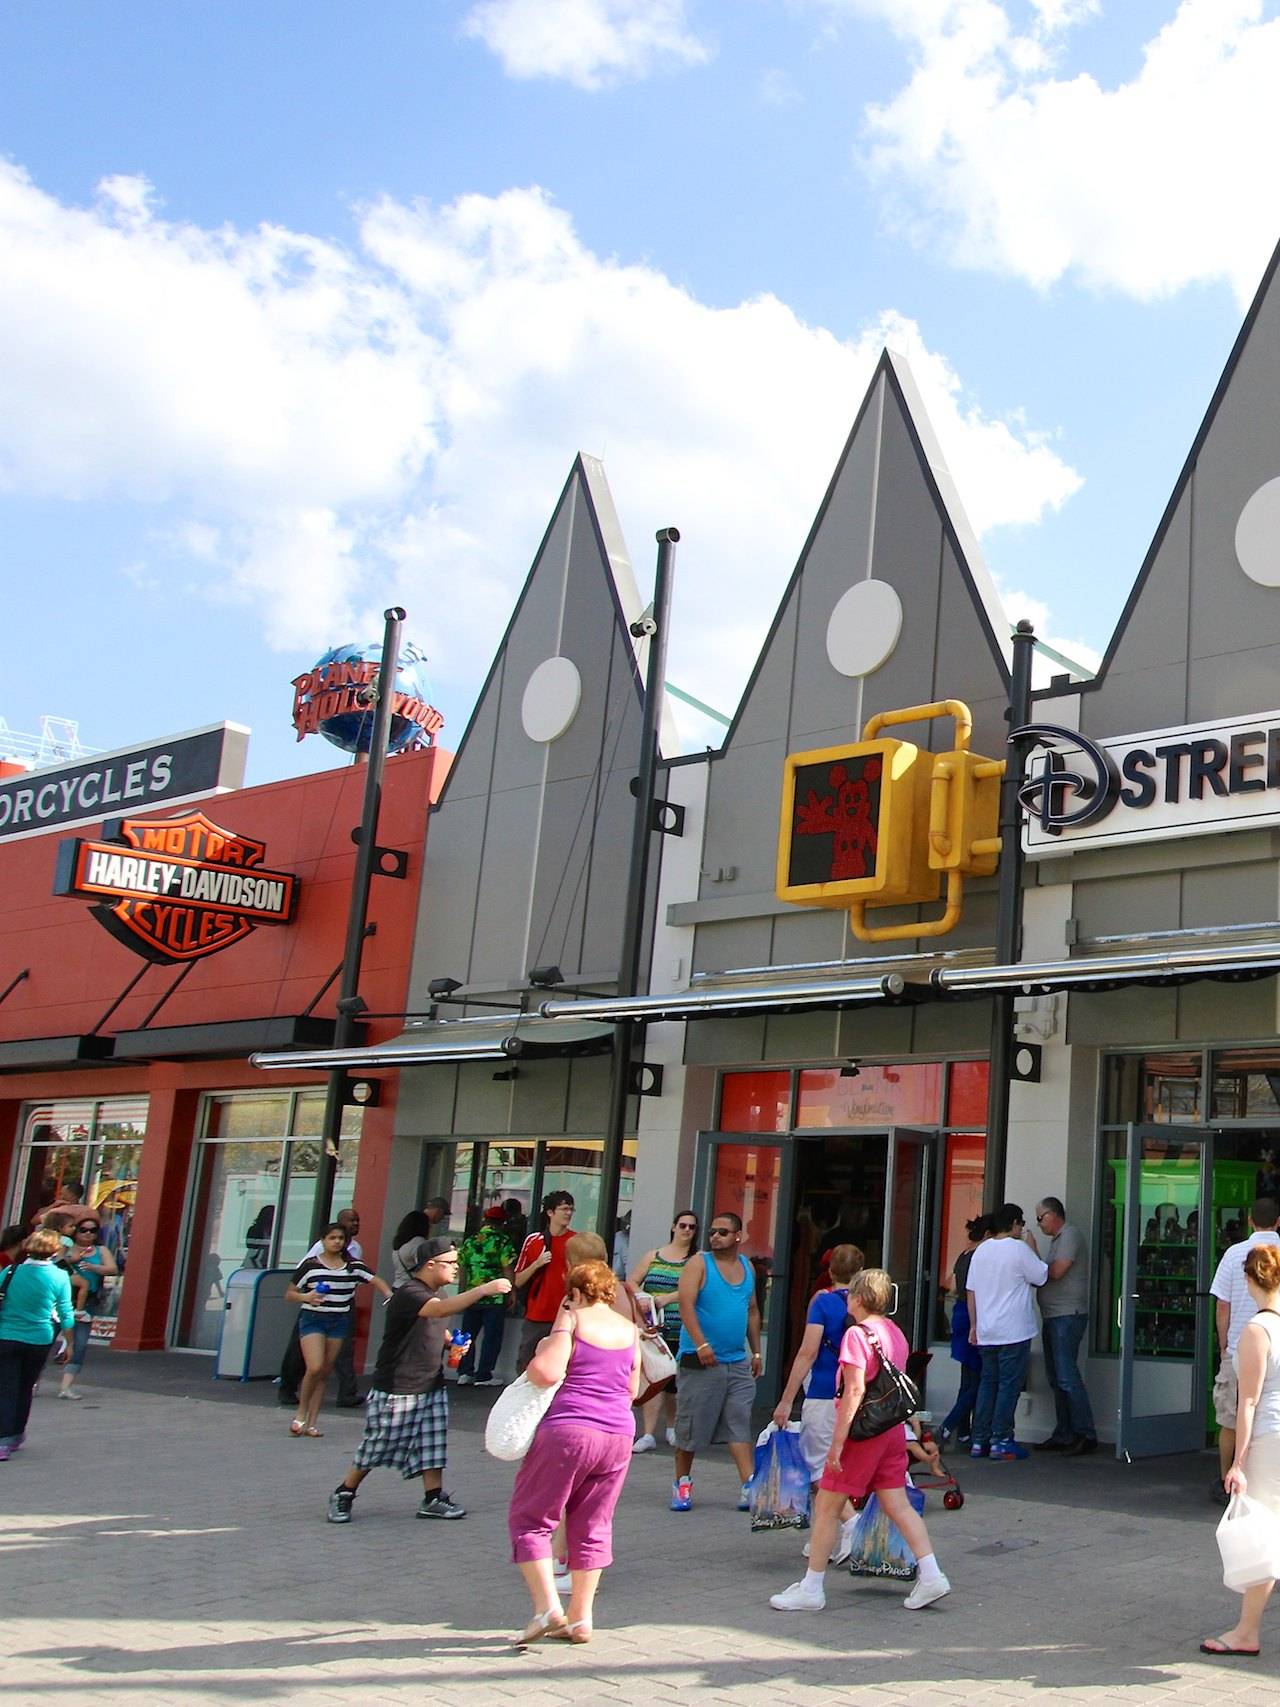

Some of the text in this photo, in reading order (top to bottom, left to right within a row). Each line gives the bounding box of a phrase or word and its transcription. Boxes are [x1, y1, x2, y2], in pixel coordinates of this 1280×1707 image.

[291, 660, 404, 702] PLANE
[292, 687, 444, 742] HOLLWOOD
[142, 822, 245, 866] MOTOR
[88, 851, 284, 912] HARLEY-DAVIDSON
[134, 901, 235, 951] CYCLES
